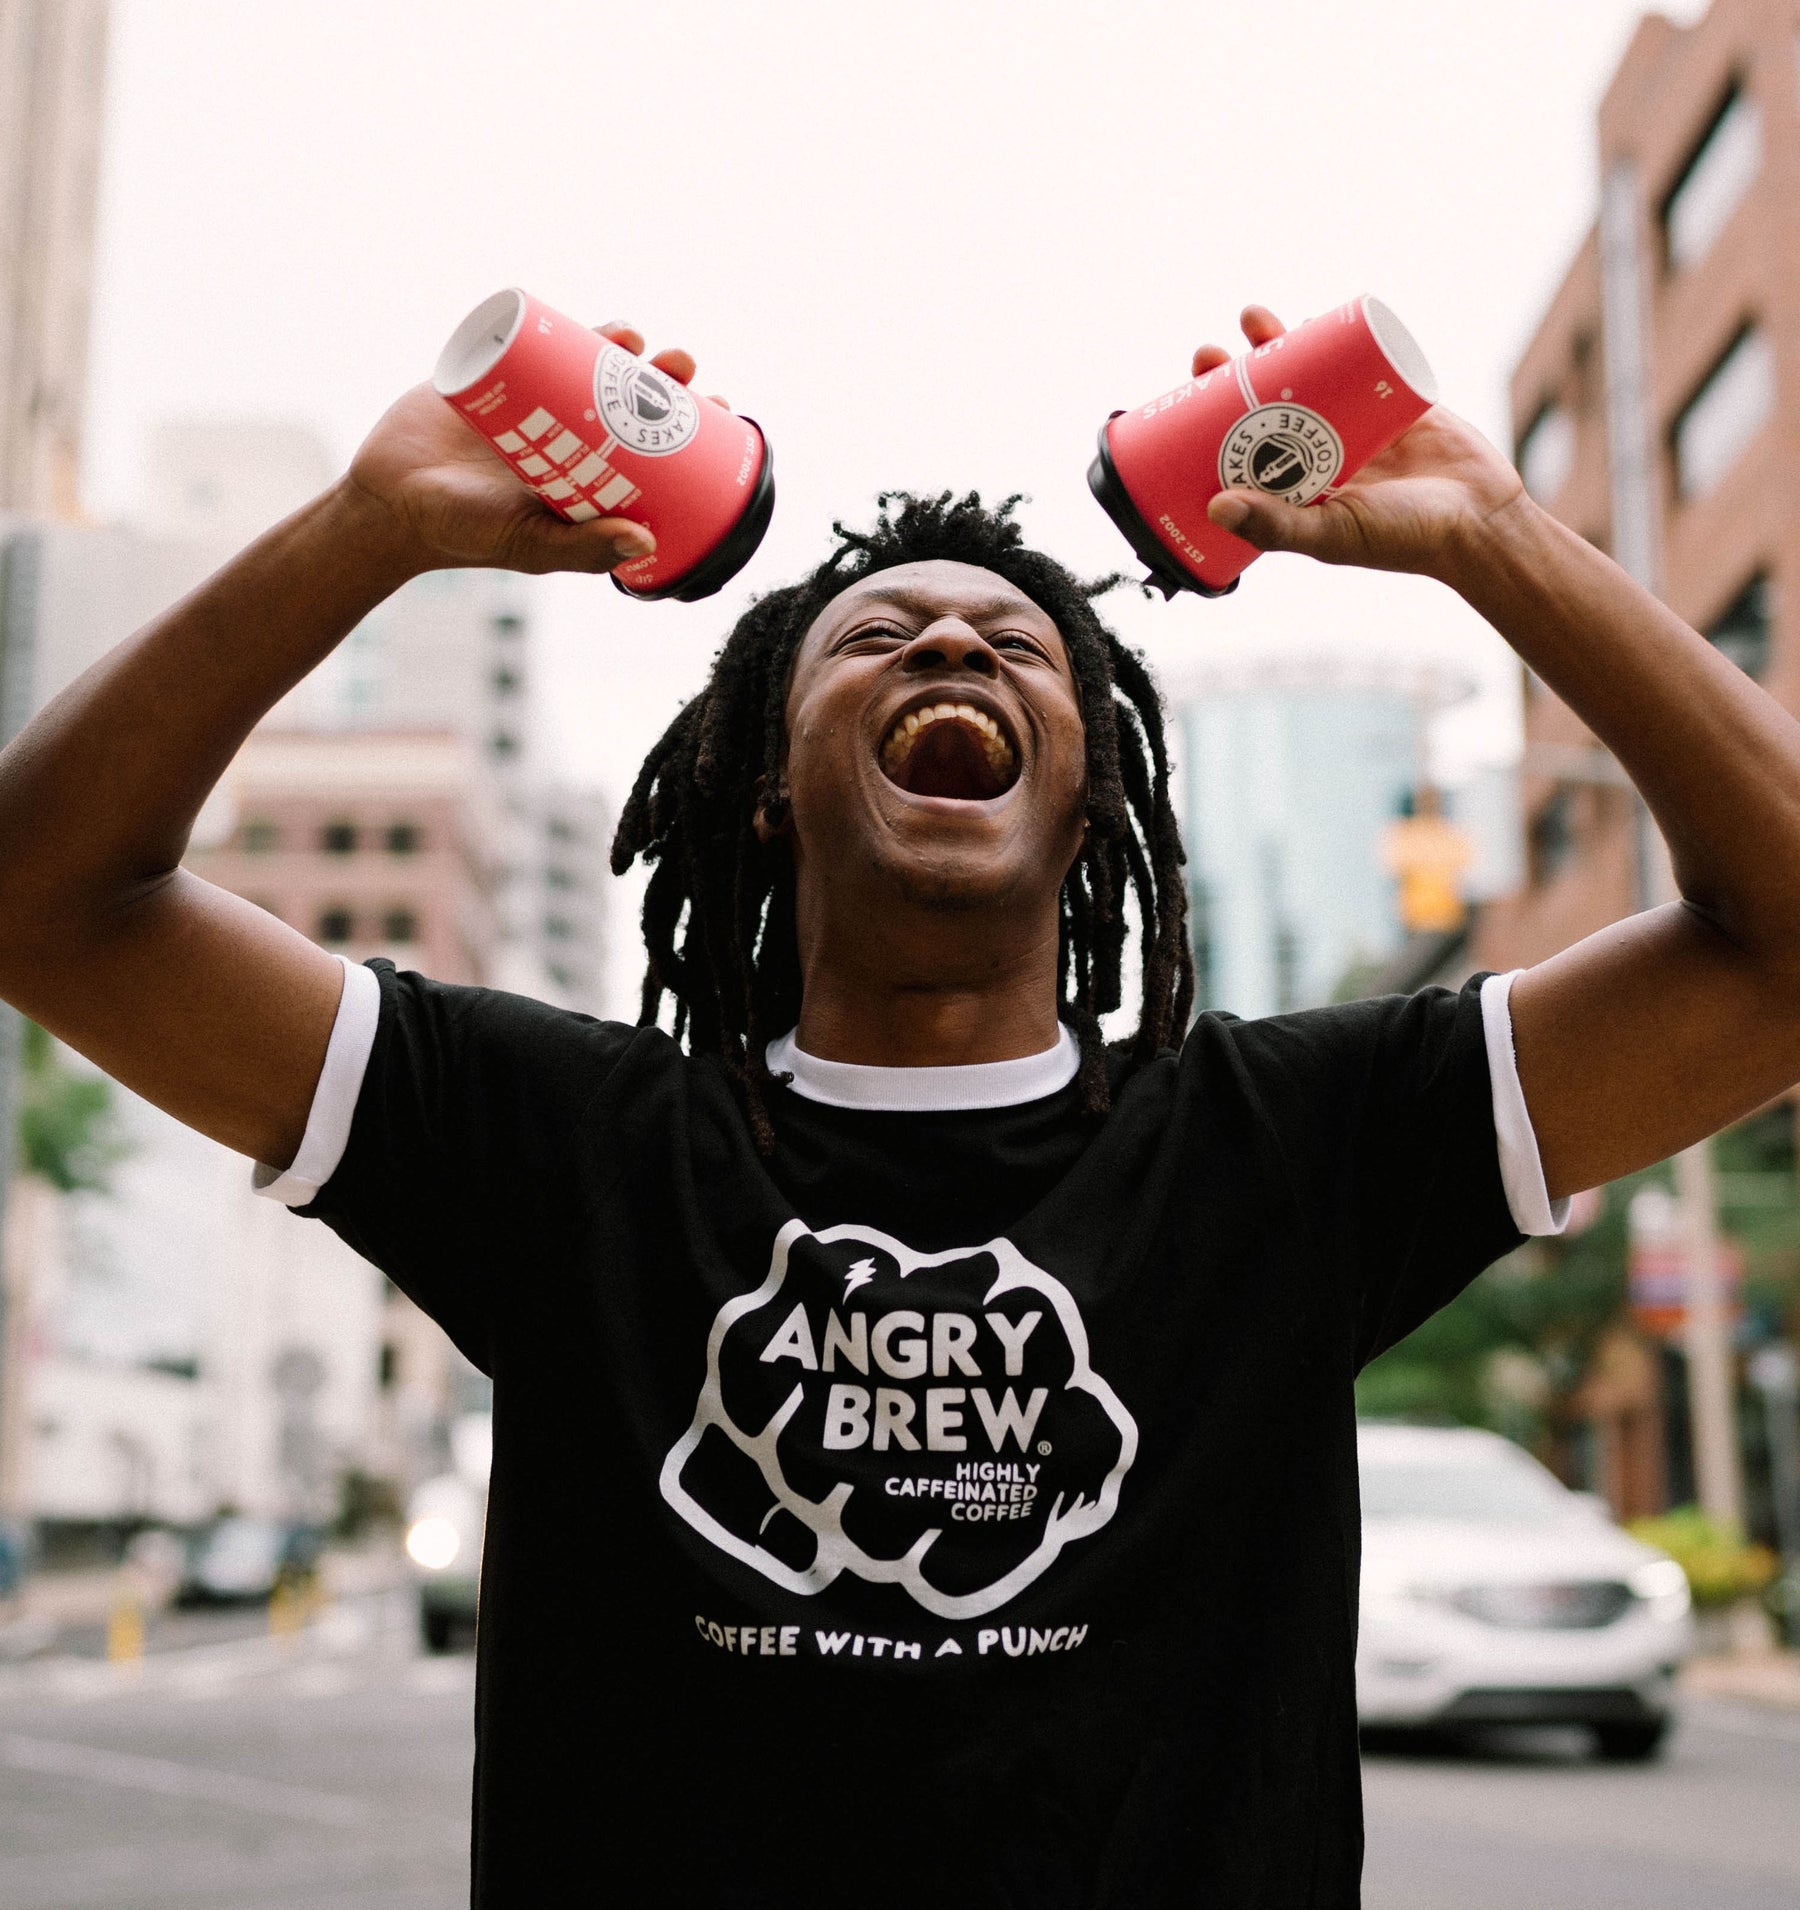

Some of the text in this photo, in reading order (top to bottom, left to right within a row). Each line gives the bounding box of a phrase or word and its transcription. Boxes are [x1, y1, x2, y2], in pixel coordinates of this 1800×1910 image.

[604, 353, 627, 412] OFFEE
[1142, 363, 1231, 420] LAKES
[1373, 380, 1394, 399] 16
[637, 410, 691, 446] LAKES
[1279, 413, 1332, 474] COFFEE
[1229, 430, 1253, 490] AKES
[1159, 514, 1206, 563] EST. 2002
[759, 1302, 1043, 1379] ANGRY
[823, 1384, 1049, 1453] BREW
[884, 1477, 1038, 1503] CAFFEINATED
[956, 1461, 1041, 1484] HIGHLY
[950, 1502, 1034, 1522] COFFEE
[694, 1615, 1089, 1660] COFFEE WITH A PUNCH
